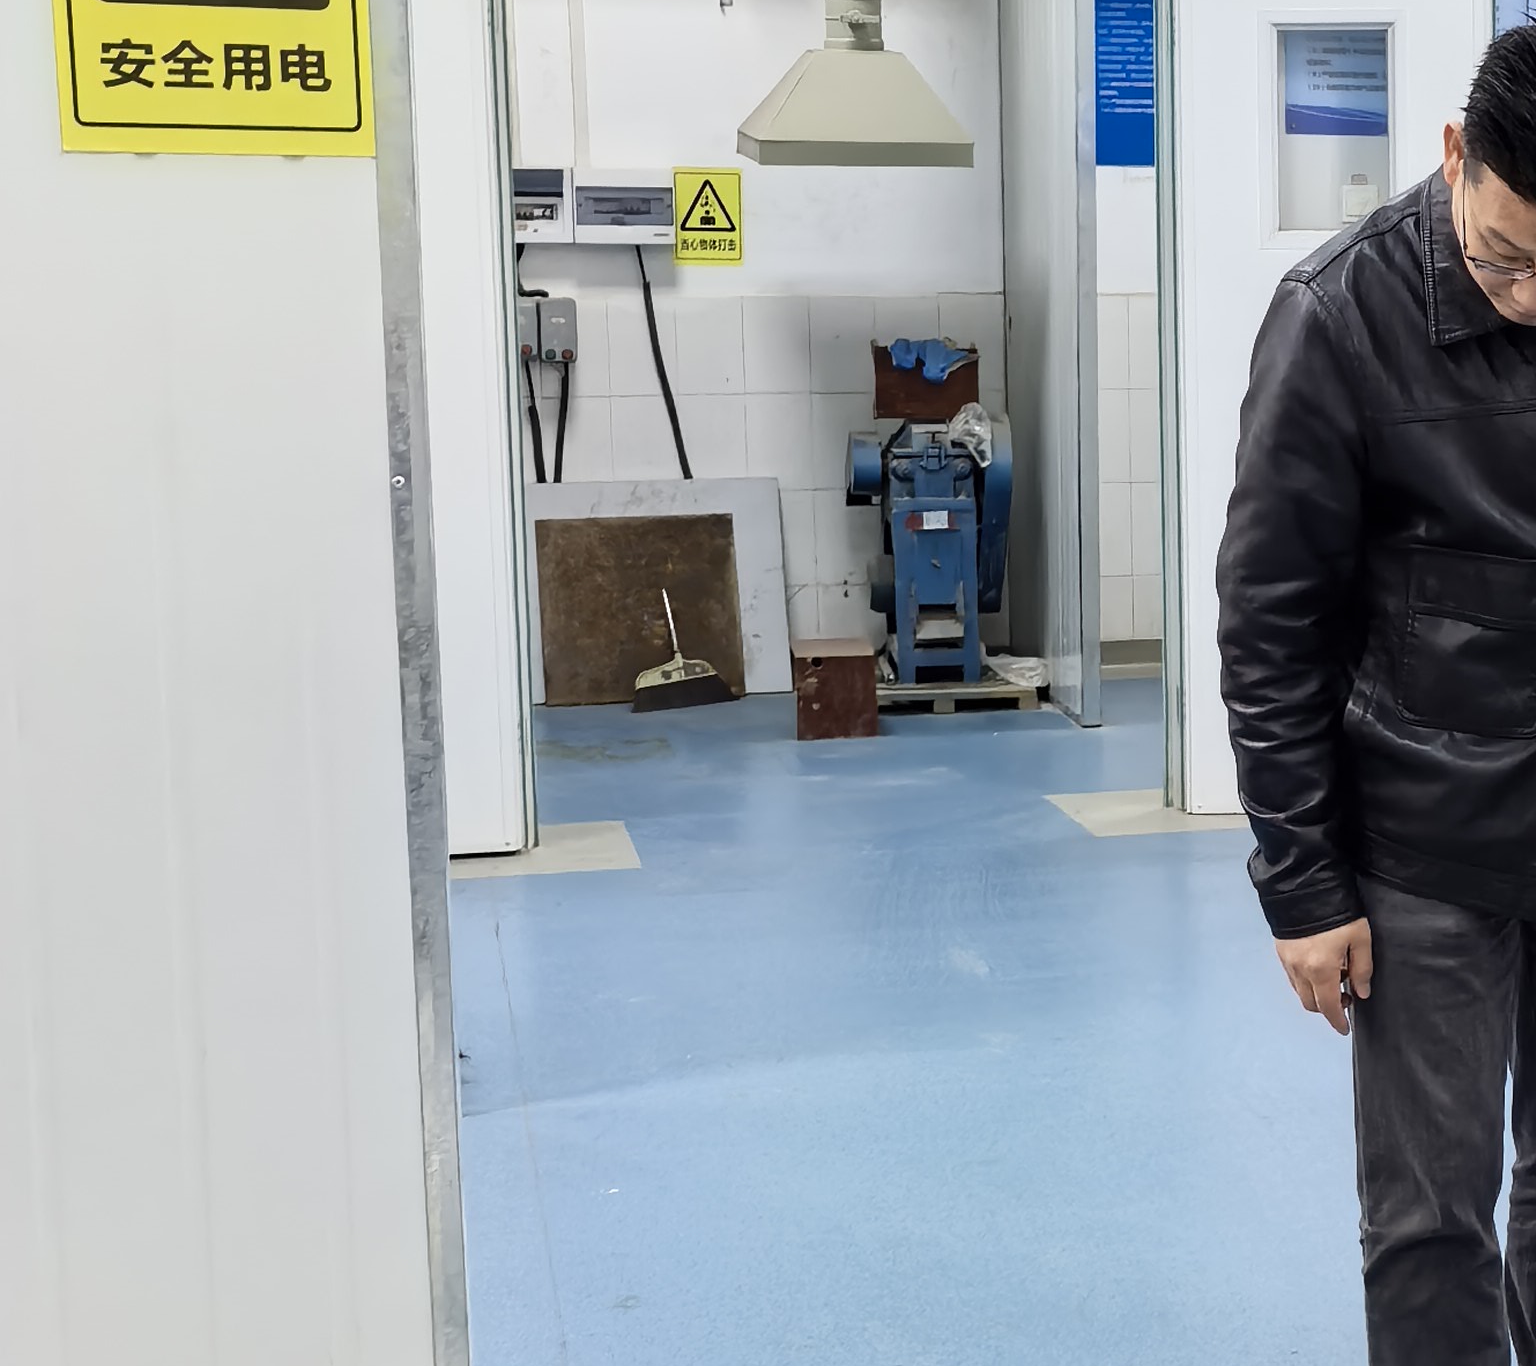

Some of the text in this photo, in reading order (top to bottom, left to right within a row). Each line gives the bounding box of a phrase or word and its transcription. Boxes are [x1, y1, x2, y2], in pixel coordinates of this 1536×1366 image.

[99, 38, 333, 93] 安全用电
[680, 237, 737, 252] 当心物体打击
